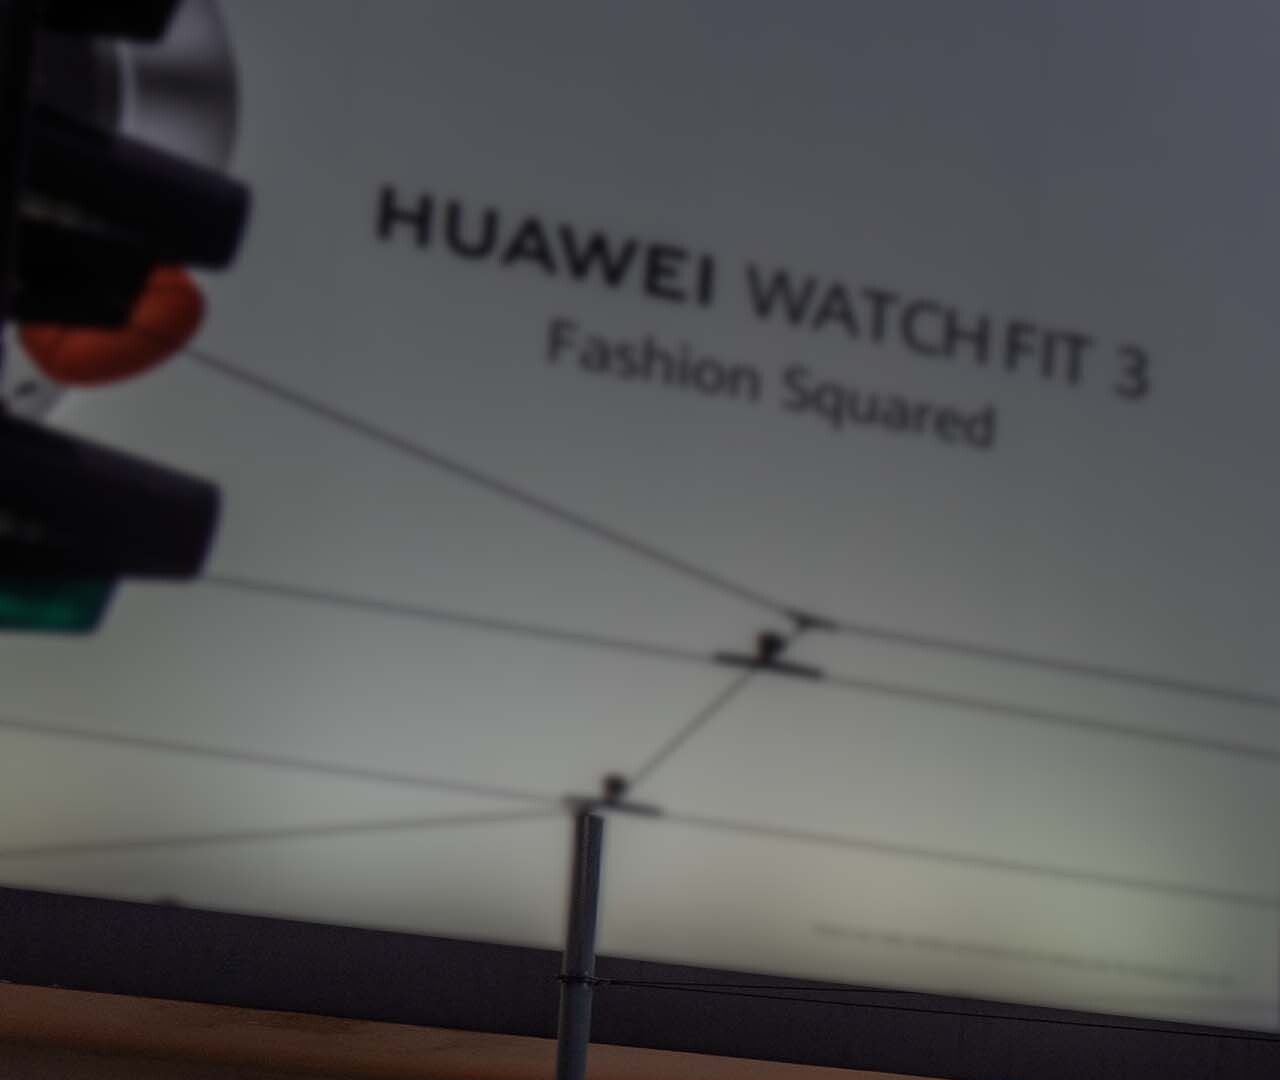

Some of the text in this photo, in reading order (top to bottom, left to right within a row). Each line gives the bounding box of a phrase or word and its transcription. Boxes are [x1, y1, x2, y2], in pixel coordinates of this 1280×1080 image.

[374, 184, 1150, 402] HUAWEI WATCH FIT 3
[546, 318, 999, 451] Fashion Squared
